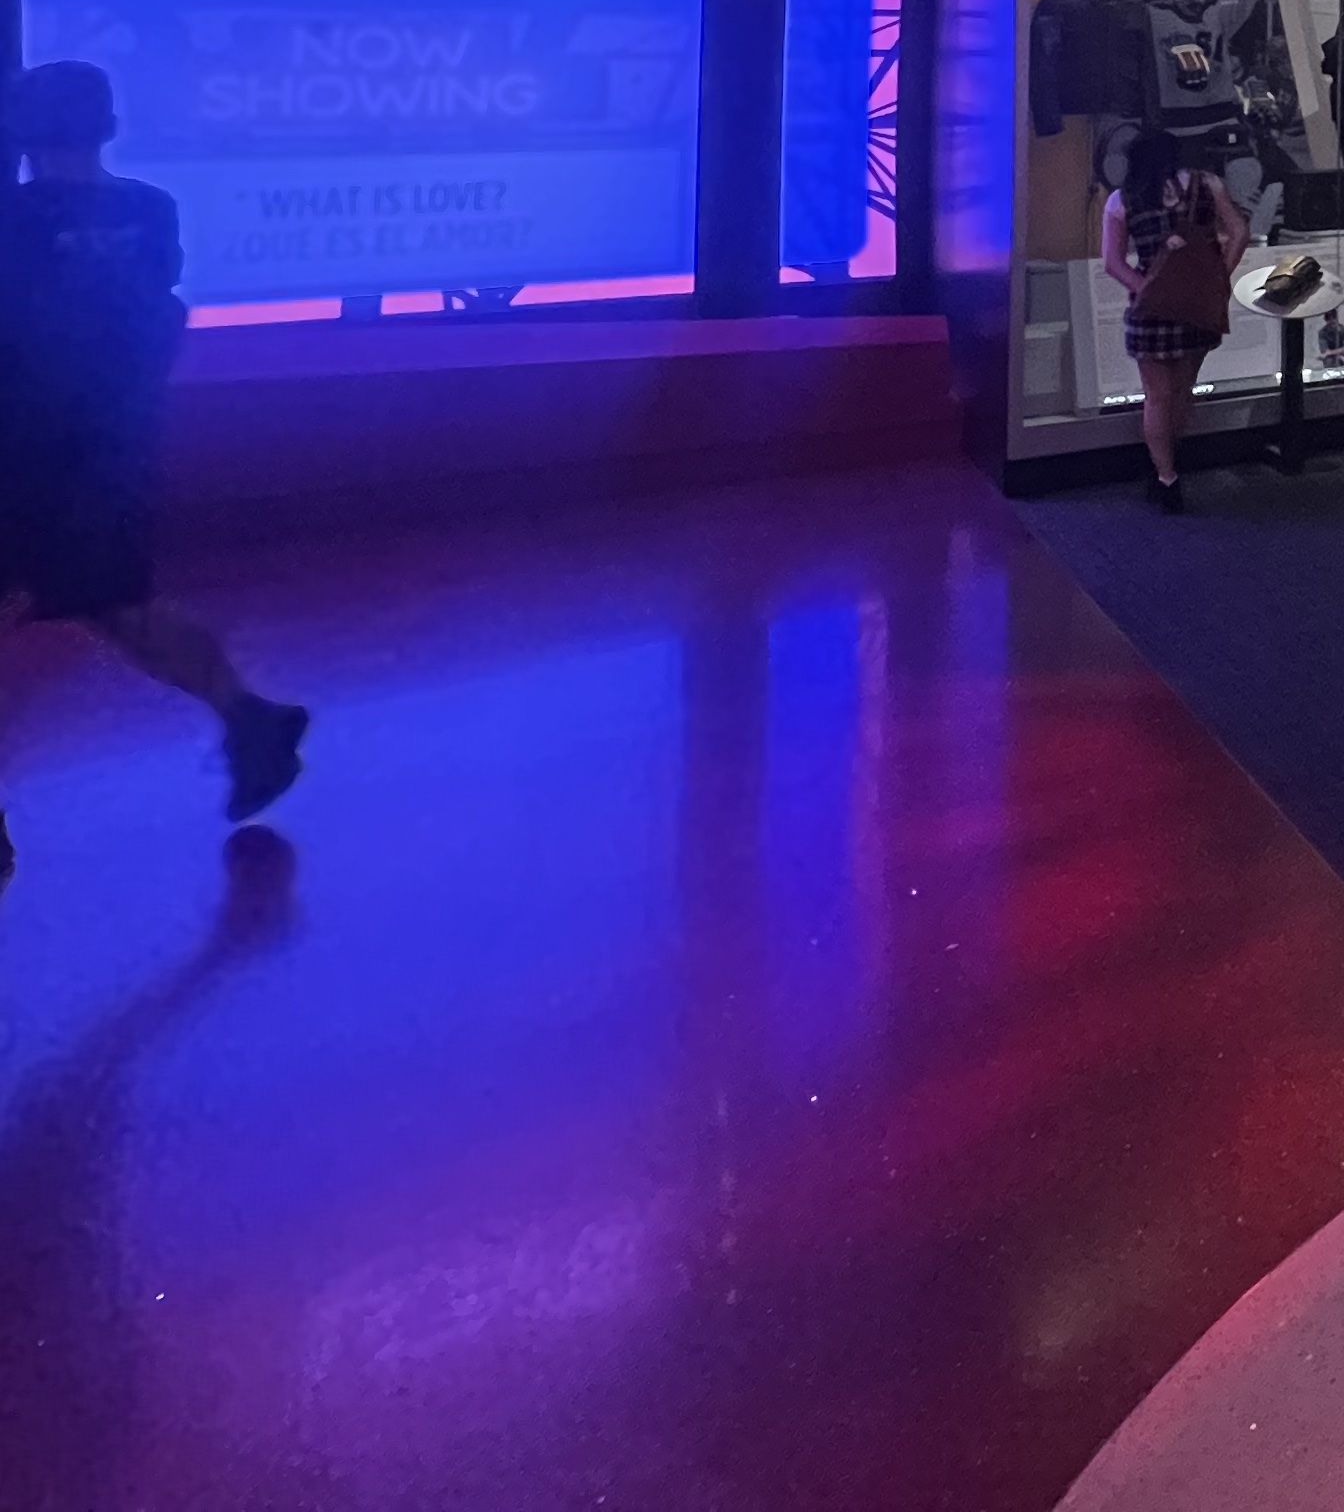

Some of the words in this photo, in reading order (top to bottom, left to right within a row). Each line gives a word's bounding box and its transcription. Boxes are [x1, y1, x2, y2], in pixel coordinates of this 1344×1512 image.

[292, 22, 471, 70] NOW
[200, 72, 540, 119] SHOWING
[258, 184, 361, 219] WHAT
[374, 182, 404, 215] IS
[413, 178, 507, 213] LOVE?
[326, 223, 364, 259] ES
